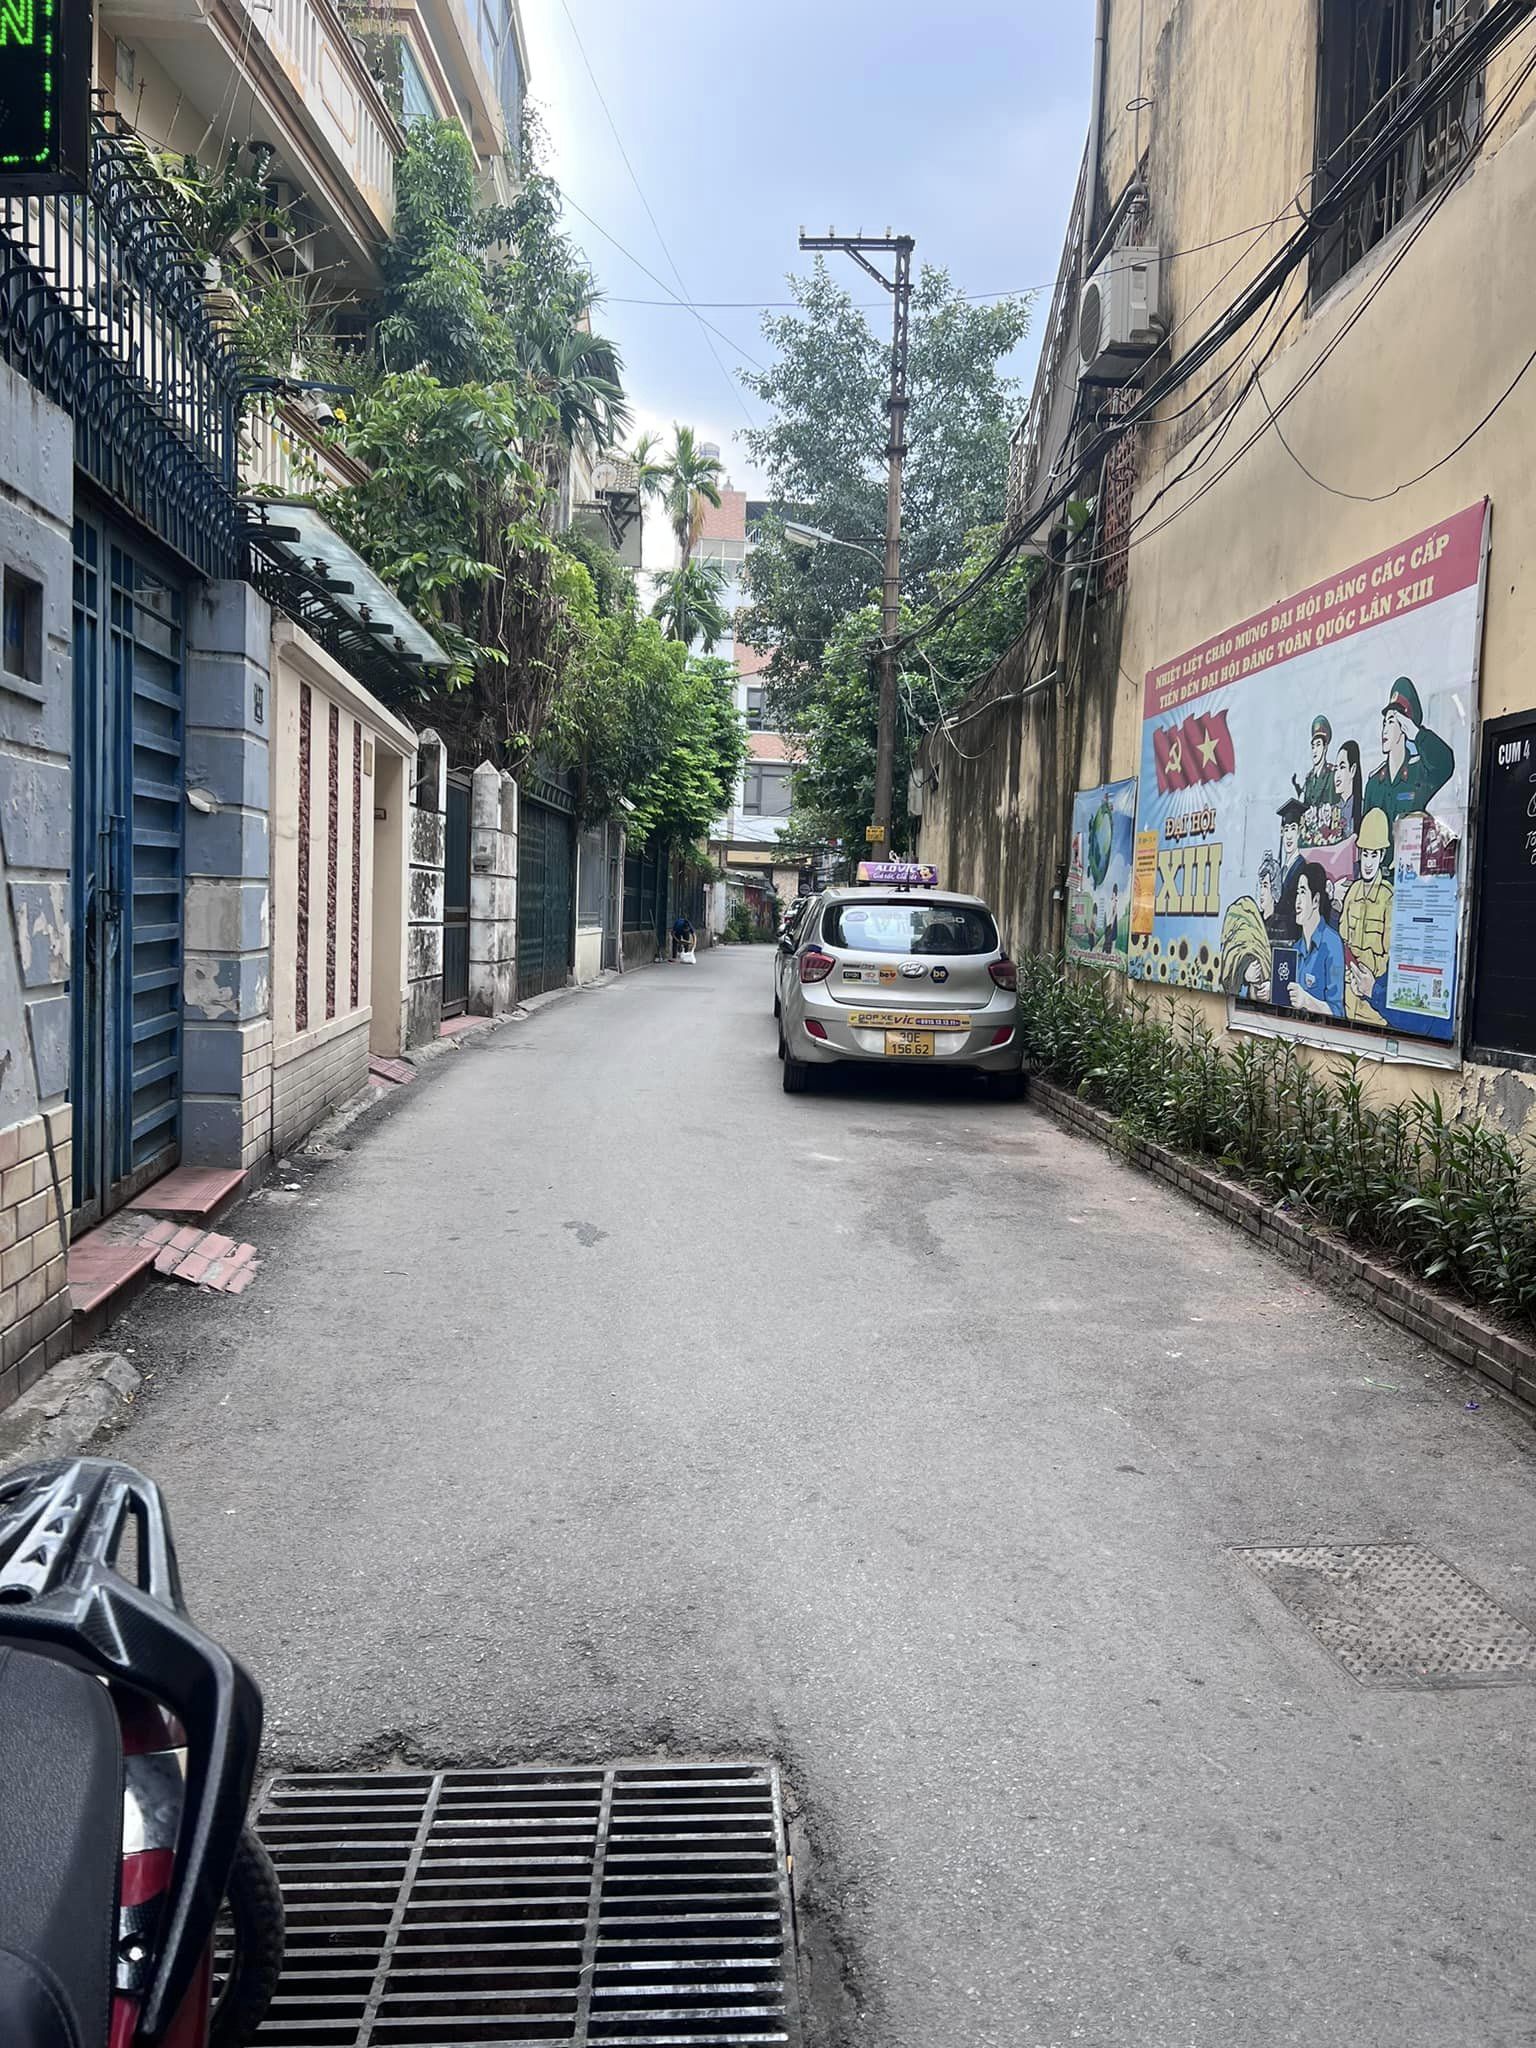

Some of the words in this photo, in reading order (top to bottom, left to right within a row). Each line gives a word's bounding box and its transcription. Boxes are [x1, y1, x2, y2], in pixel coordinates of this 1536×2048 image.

[1155, 665, 1182, 690] NHIỆT
[1183, 654, 1204, 677] LIỆT
[1205, 639, 1233, 665] CHÀO
[1235, 621, 1268, 651] MỪNG
[1271, 609, 1293, 633] ĐẠI
[1295, 595, 1321, 622] HỘI
[1324, 573, 1367, 609] ĐẢNG
[1371, 555, 1406, 587] CÁC
[1410, 532, 1450, 569] CẤP
[1160, 686, 1179, 709] TIẾN
[1180, 677, 1200, 700] ĐẾN
[1201, 670, 1219, 692] ĐẠI
[1220, 659, 1241, 684] HỘI
[1242, 644, 1275, 670] ĐẢNG
[1277, 629, 1312, 658] TOÀN
[1315, 607, 1356, 645] QUỐC
[1359, 591, 1393, 625] LẦN
[1396, 576, 1434, 610] XIII
[1498, 741, 1522, 770] CỤM
[1523, 739, 1531, 761] 4
[1165, 814, 1188, 843] ĐẠI
[1190, 804, 1217, 840] HỘI
[1155, 843, 1223, 917] XIII
[933, 970, 946, 978] be
[892, 1044, 929, 1055] 156.62
[900, 1033, 921, 1043] 30E
